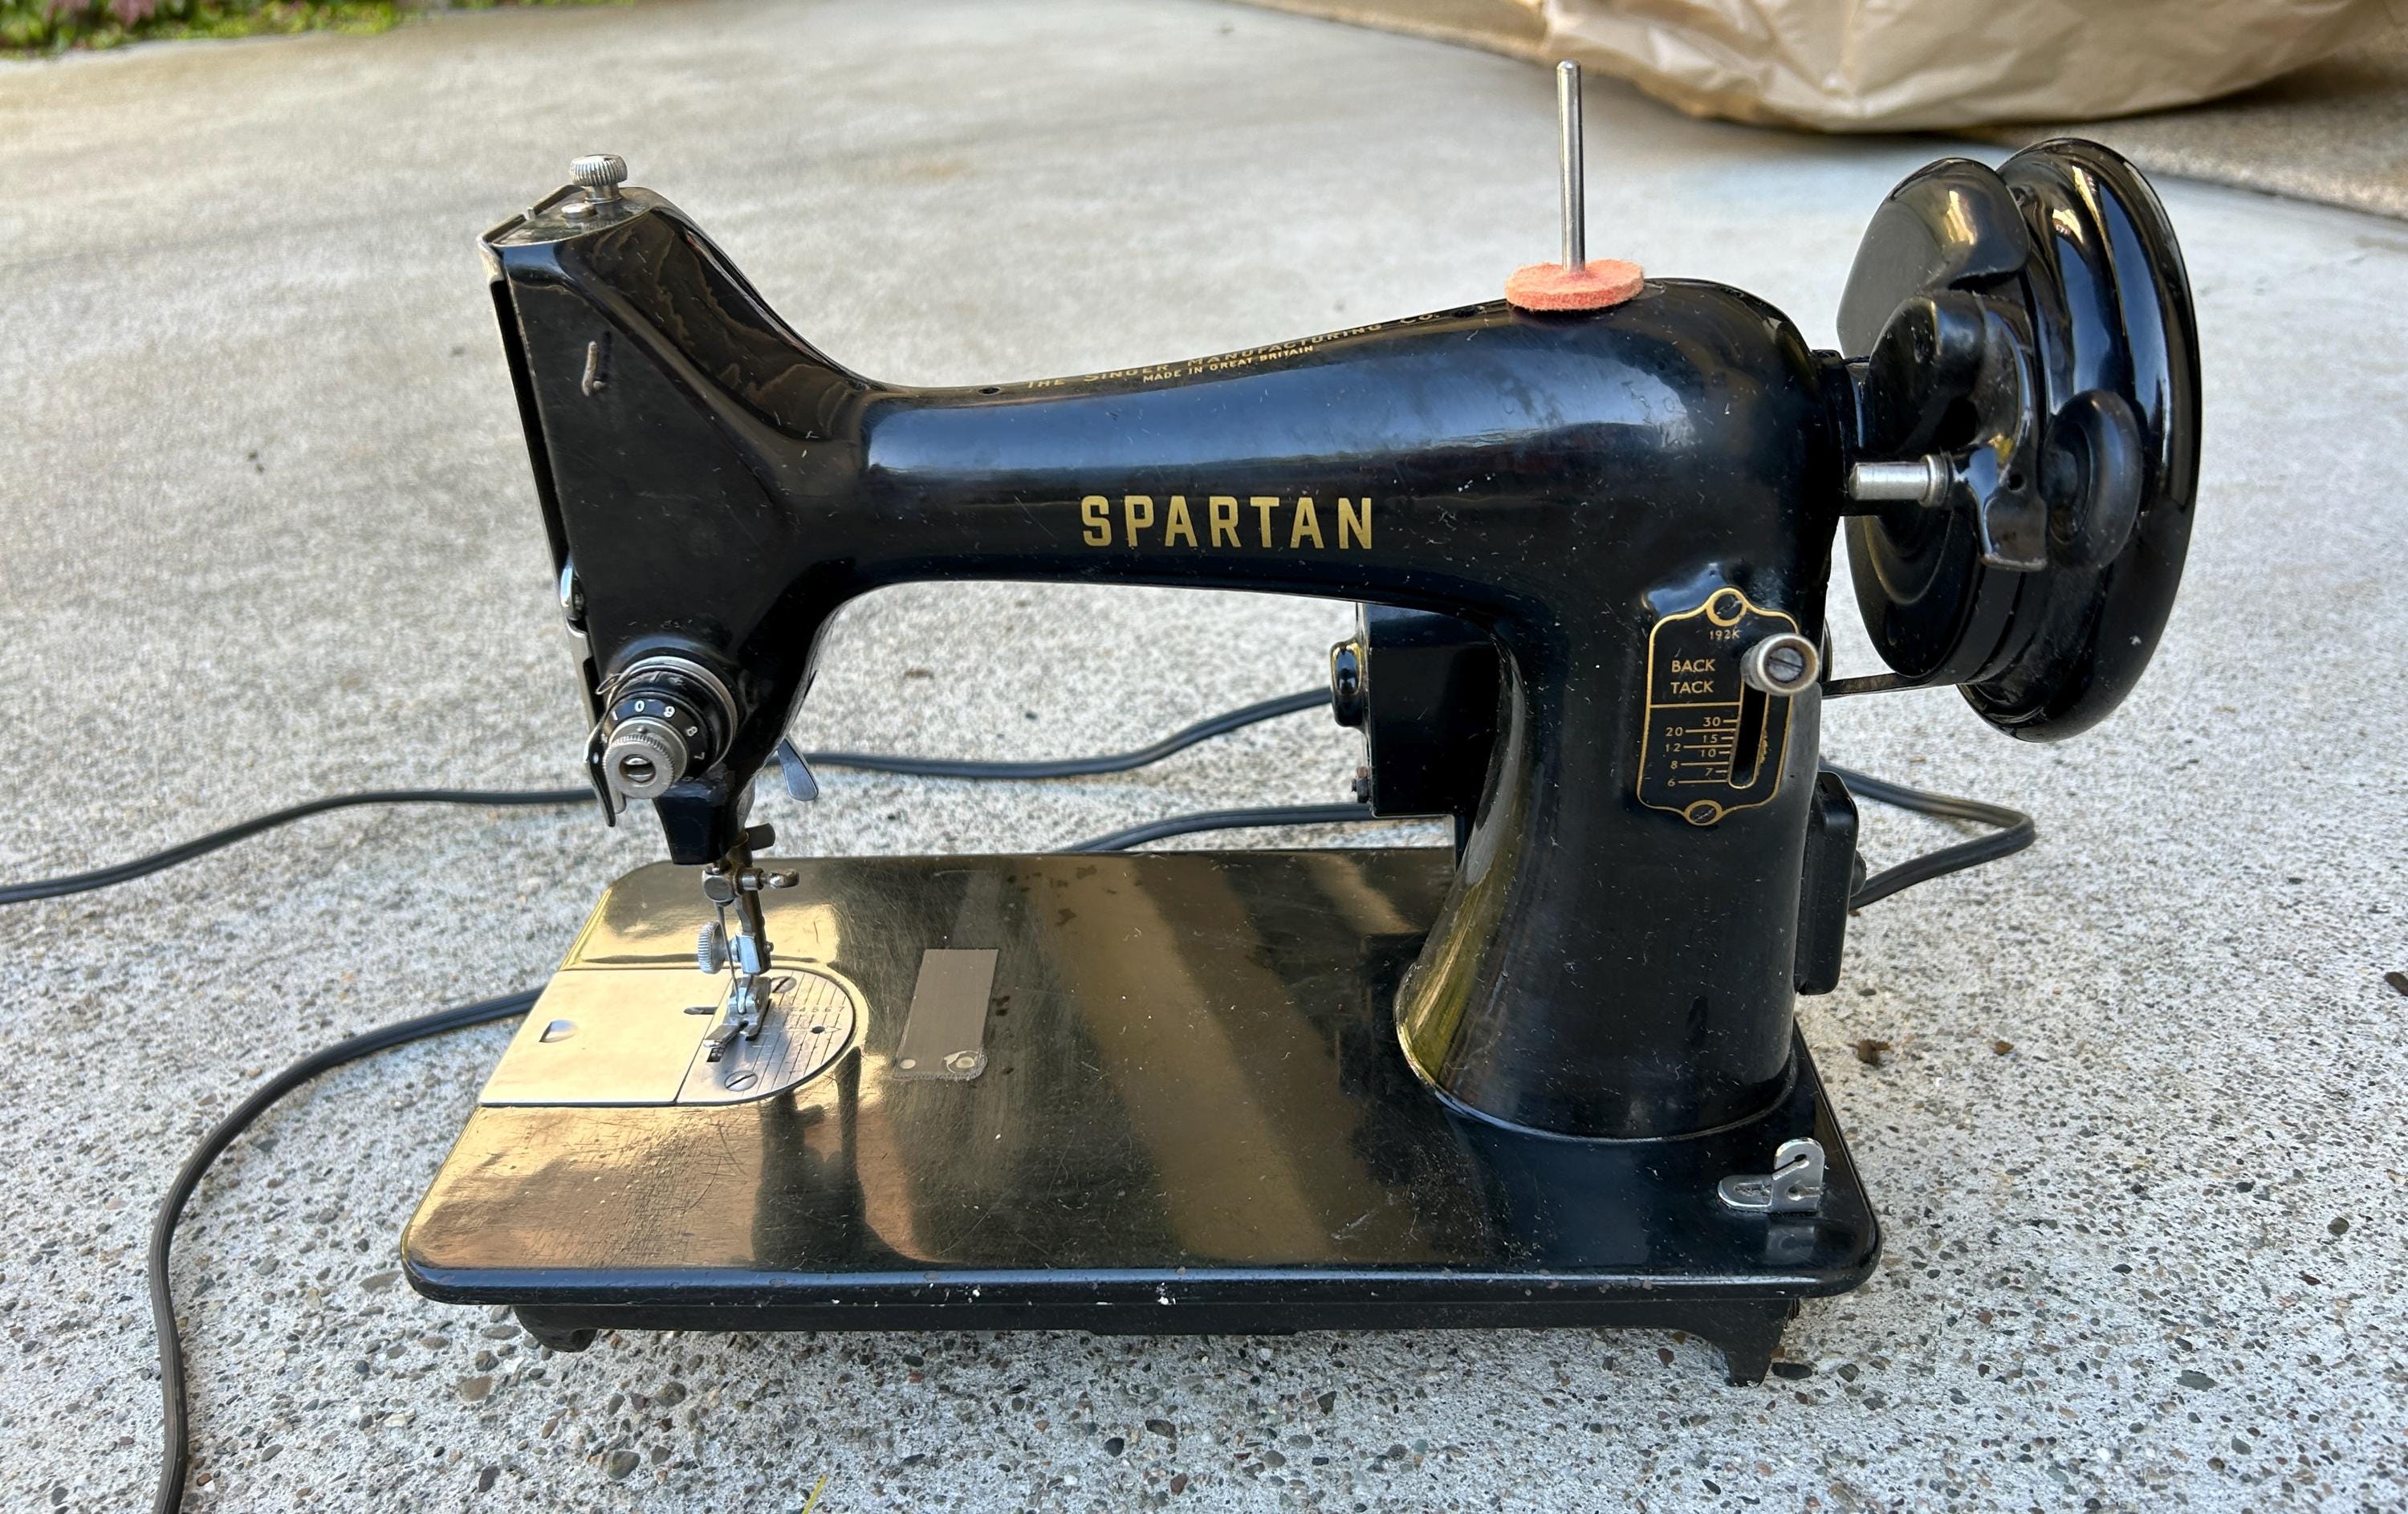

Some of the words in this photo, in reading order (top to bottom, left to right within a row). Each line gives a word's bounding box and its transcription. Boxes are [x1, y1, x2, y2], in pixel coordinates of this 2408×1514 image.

[1027, 378, 1065, 389] THE
[1084, 364, 1169, 382] SINGER
[1187, 324, 1382, 367] MANUFACTURING
[1142, 369, 1182, 383] MADE
[1188, 367, 1203, 375] IN
[1210, 357, 1253, 372] GREAT
[1259, 345, 1314, 361] BRITAIN
[1080, 494, 1373, 550] SPARTAN
[1709, 629, 1742, 641] 192K
[1671, 658, 1716, 673] BACK
[1670, 680, 1714, 694] TACK
[1702, 716, 1722, 727] 30
[634, 700, 645, 713] 0
[663, 706, 676, 718] 9
[686, 726, 698, 737] 8
[694, 751, 706, 760] 7
[1665, 726, 1683, 737] 20
[1702, 734, 1719, 743] 15
[1665, 743, 1682, 752] 12
[1701, 748, 1717, 758] 10
[1670, 760, 1678, 770] 8
[1705, 767, 1714, 776] 7
[1667, 778, 1676, 787] 6
